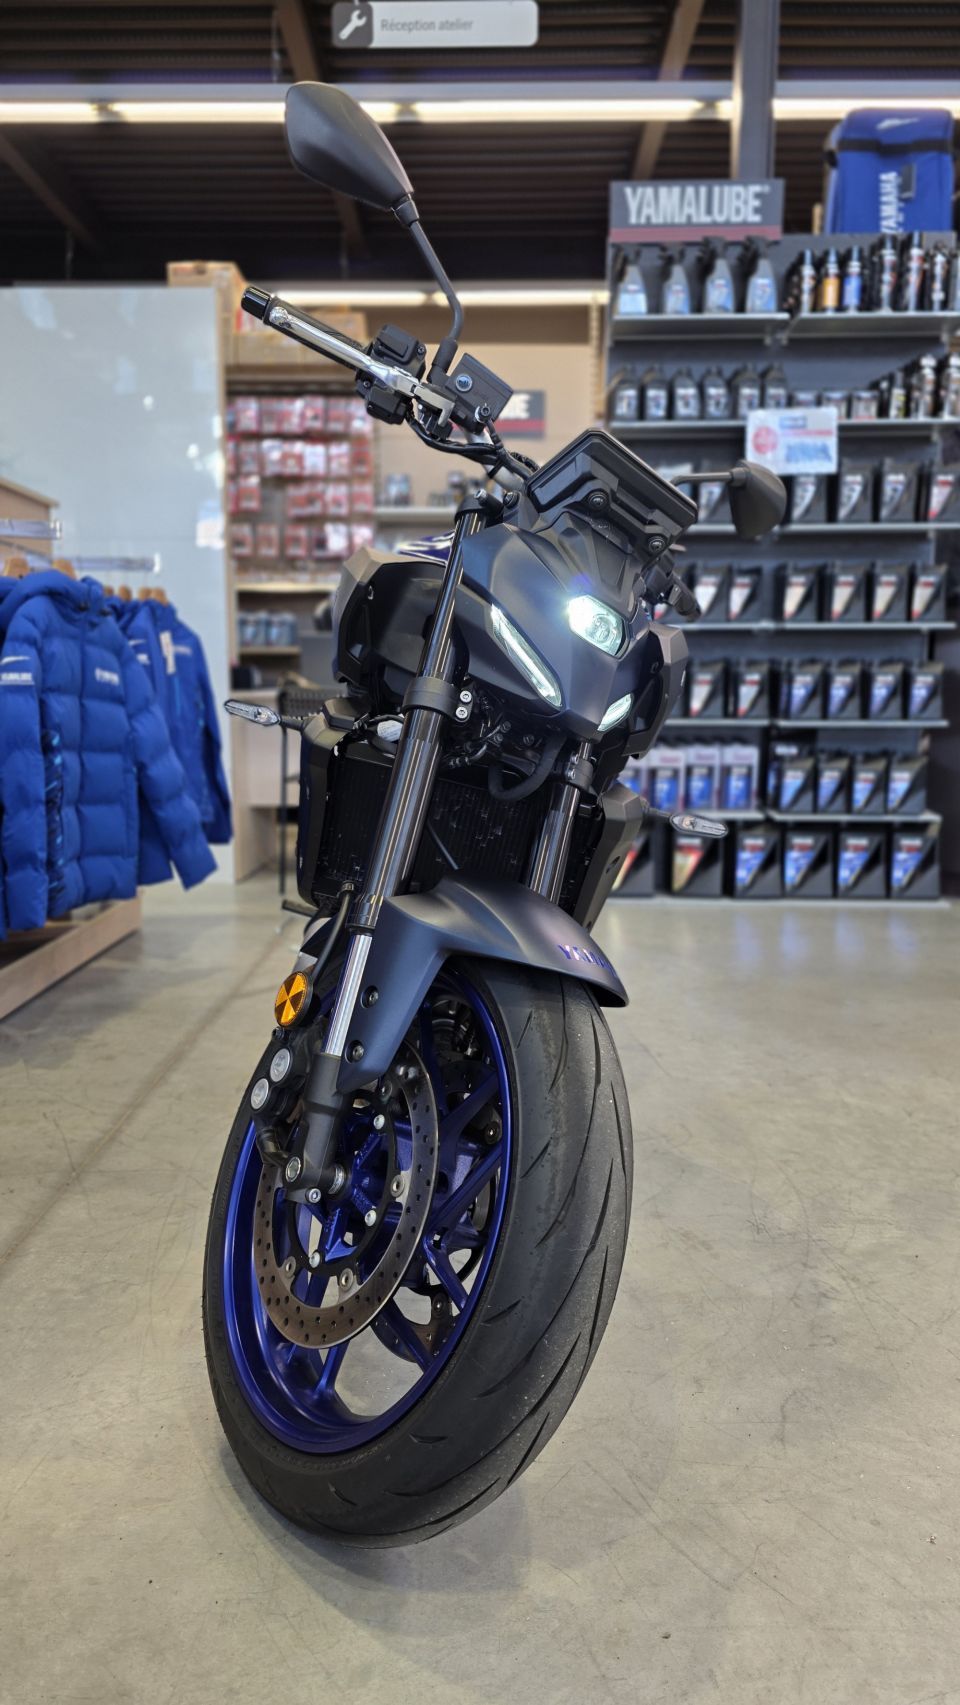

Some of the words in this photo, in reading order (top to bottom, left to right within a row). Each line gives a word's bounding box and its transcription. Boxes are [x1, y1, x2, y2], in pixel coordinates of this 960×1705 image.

[381, 19, 436, 33] Réception
[438, 19, 473, 31] atelier
[500, 393, 530, 419] BE
